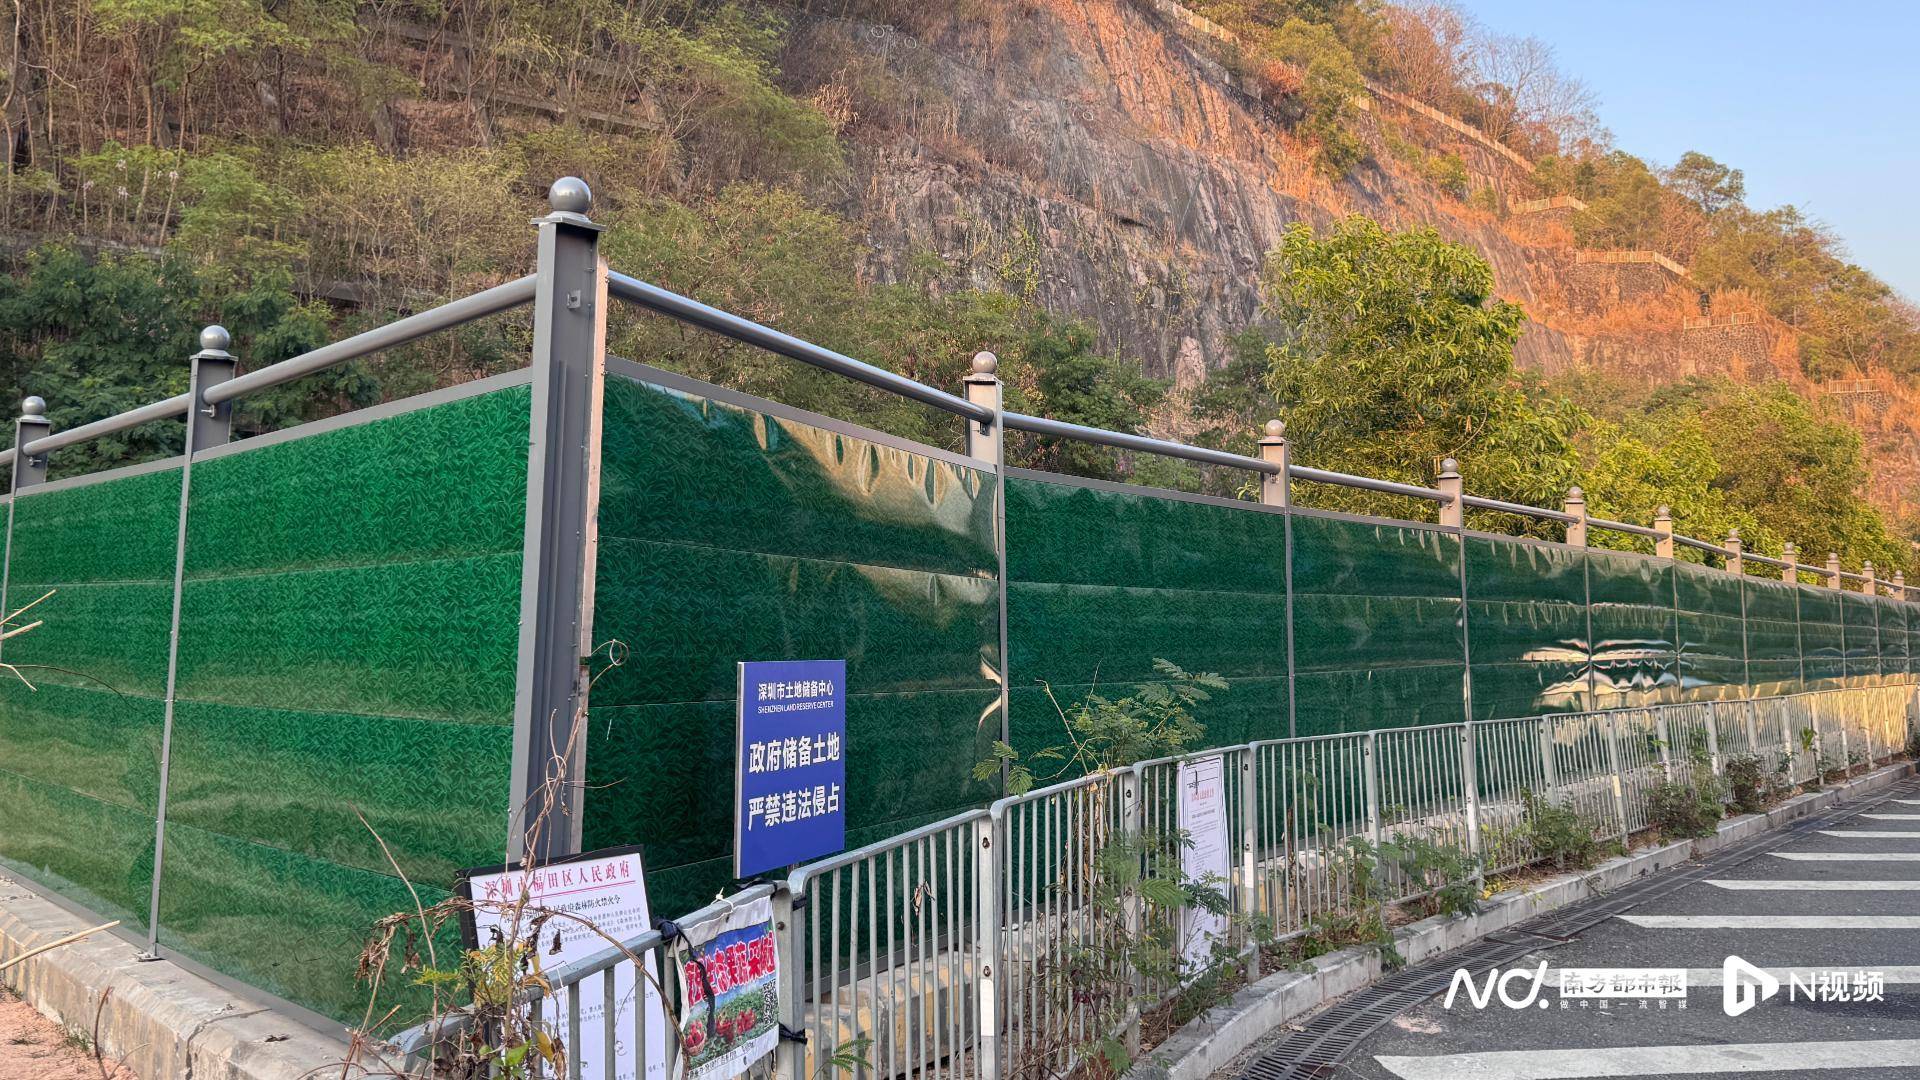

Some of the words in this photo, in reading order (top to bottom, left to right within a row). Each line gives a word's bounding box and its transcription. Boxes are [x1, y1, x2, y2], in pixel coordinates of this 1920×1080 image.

[758, 680, 834, 701] 深圳市土地储备中心
[757, 705, 783, 714] SHENZHEN
[784, 703, 796, 712] LAND
[797, 702, 816, 711] RESERVE
[817, 700, 834, 709] CENTER
[749, 732, 840, 774] 政府储备土地
[748, 782, 840, 831] 严禁违法侵占
